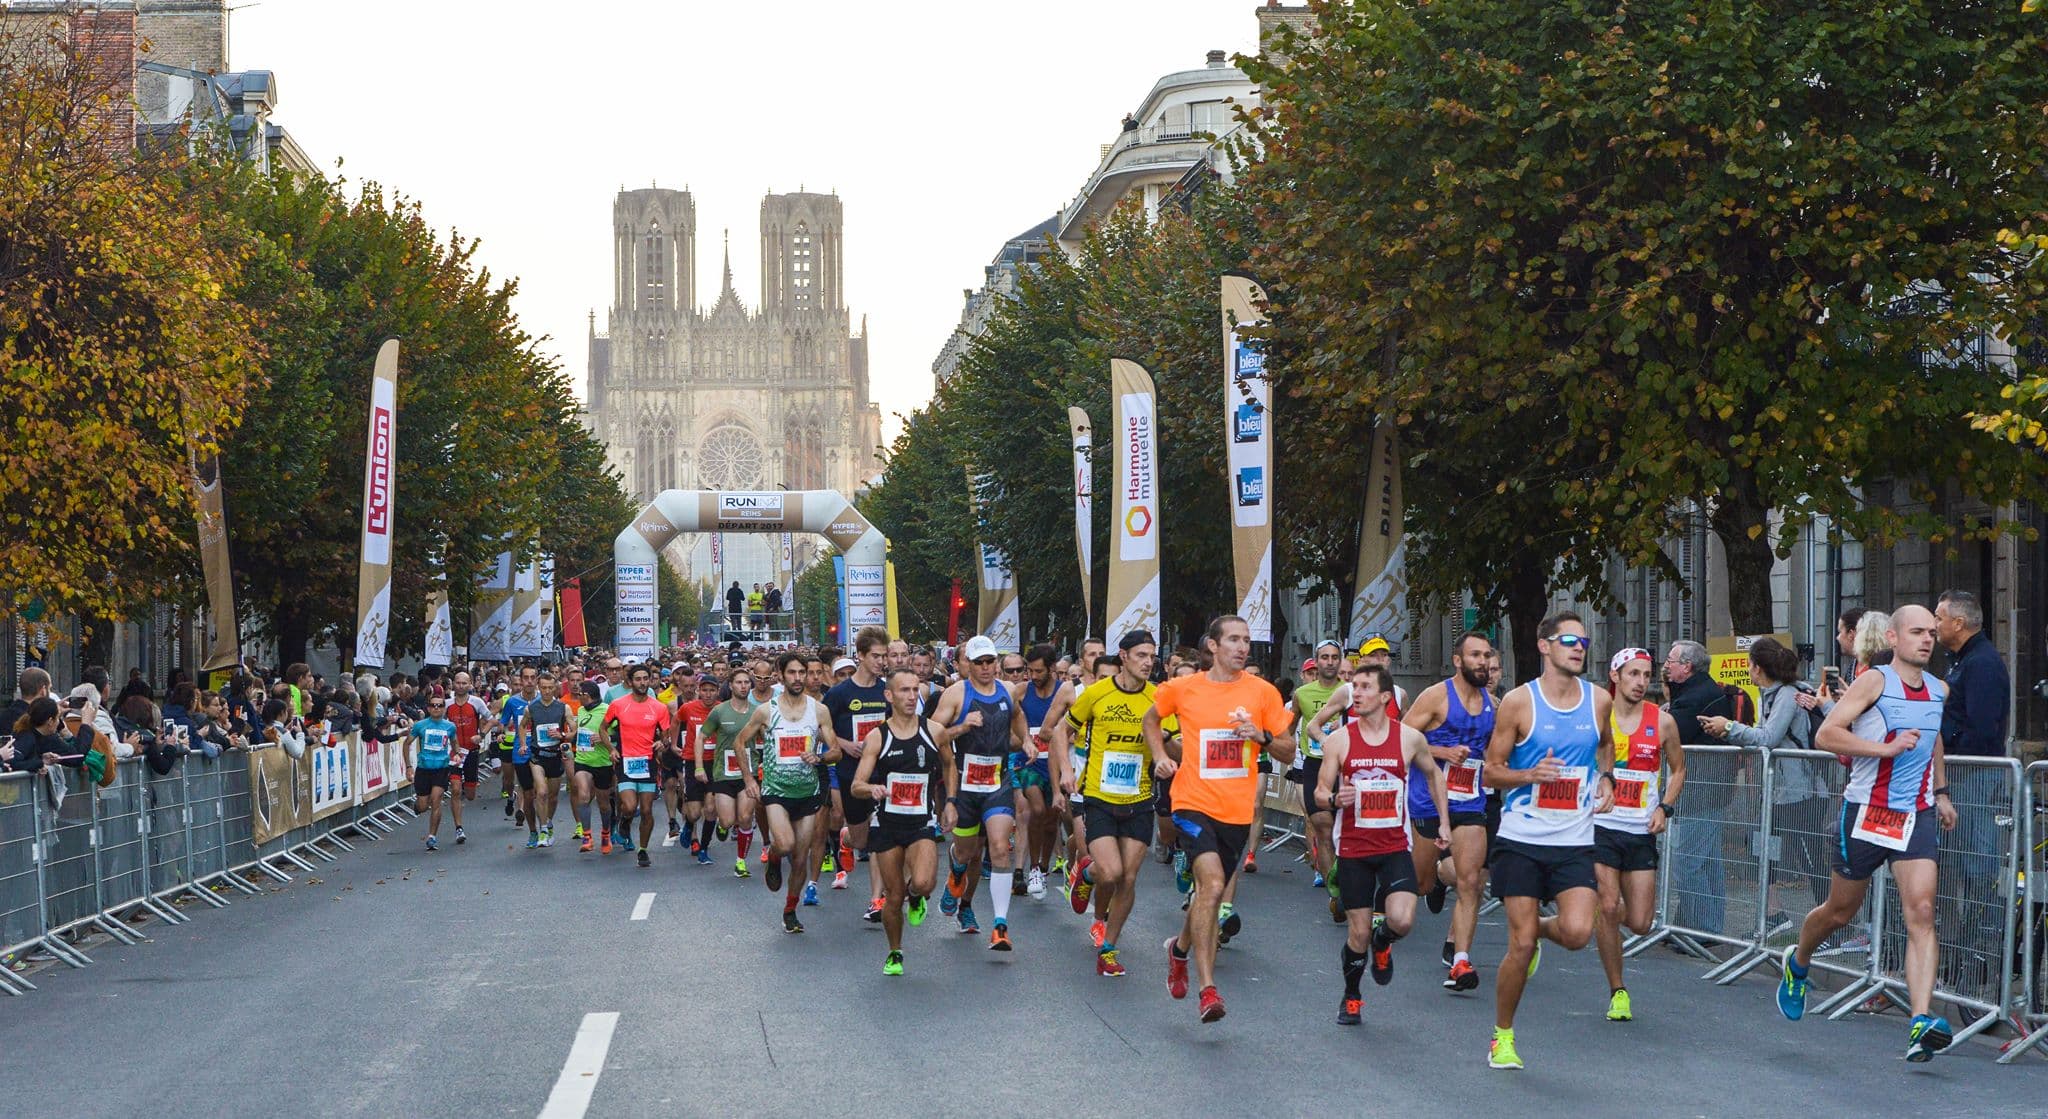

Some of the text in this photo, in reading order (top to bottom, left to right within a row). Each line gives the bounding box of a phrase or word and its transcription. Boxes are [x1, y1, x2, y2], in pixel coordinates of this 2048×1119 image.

[1240, 355, 1261, 369] bleu
[1239, 418, 1262, 432] bleu
[1128, 416, 1138, 500] Harmonie
[1140, 416, 1150, 499] mutuelle
[371, 416, 388, 529] L'union
[1242, 481, 1263, 496] bleu
[640, 523, 669, 533] Reims
[718, 521, 784, 530] DÉPART 2017
[850, 569, 880, 581] Reims
[780, 737, 805, 752] 21455
[1210, 743, 1240, 761] 21451
[1107, 762, 1137, 779] 30207
[1351, 759, 1398, 767] SPORTS PASSION
[1361, 793, 1397, 811] 20002
